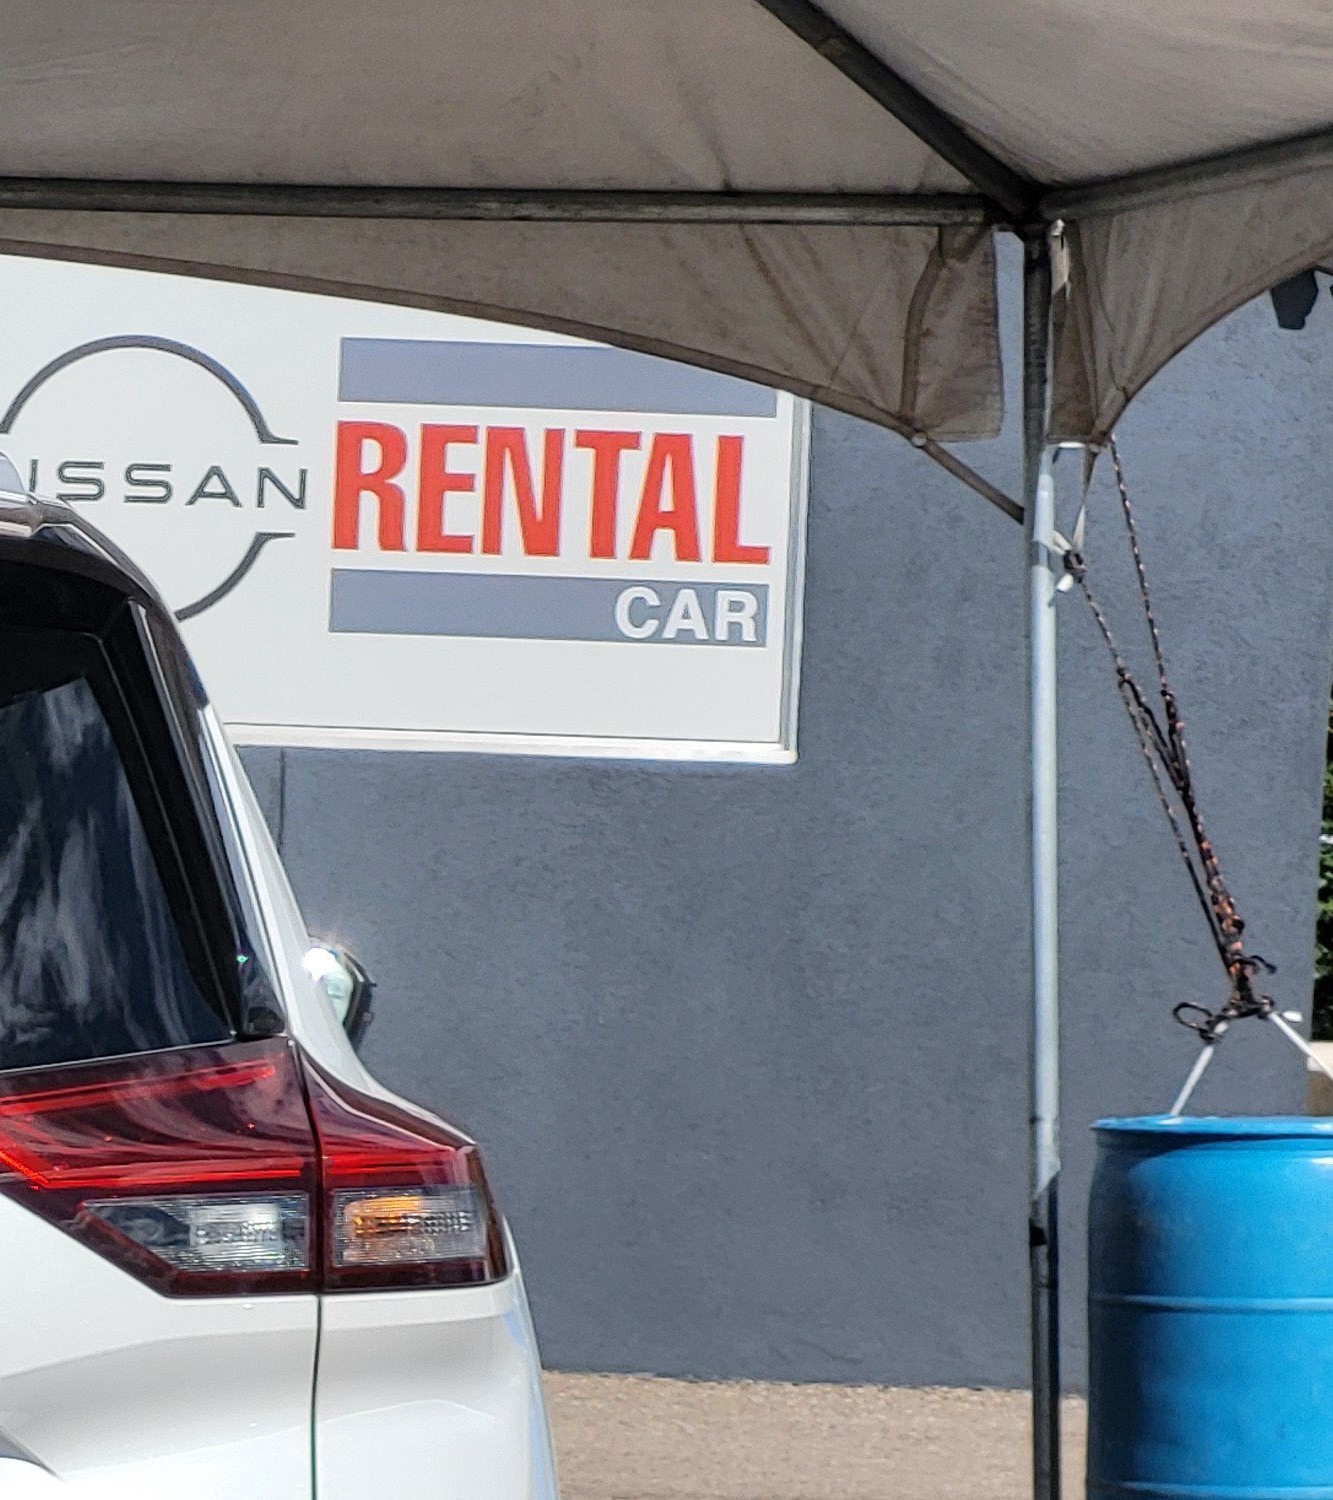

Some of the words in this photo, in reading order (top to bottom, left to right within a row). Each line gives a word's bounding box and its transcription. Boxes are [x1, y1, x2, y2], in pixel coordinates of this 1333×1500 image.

[28, 457, 308, 510] ISSAN
[333, 421, 770, 564] RENTAL
[613, 586, 758, 643] CAR
